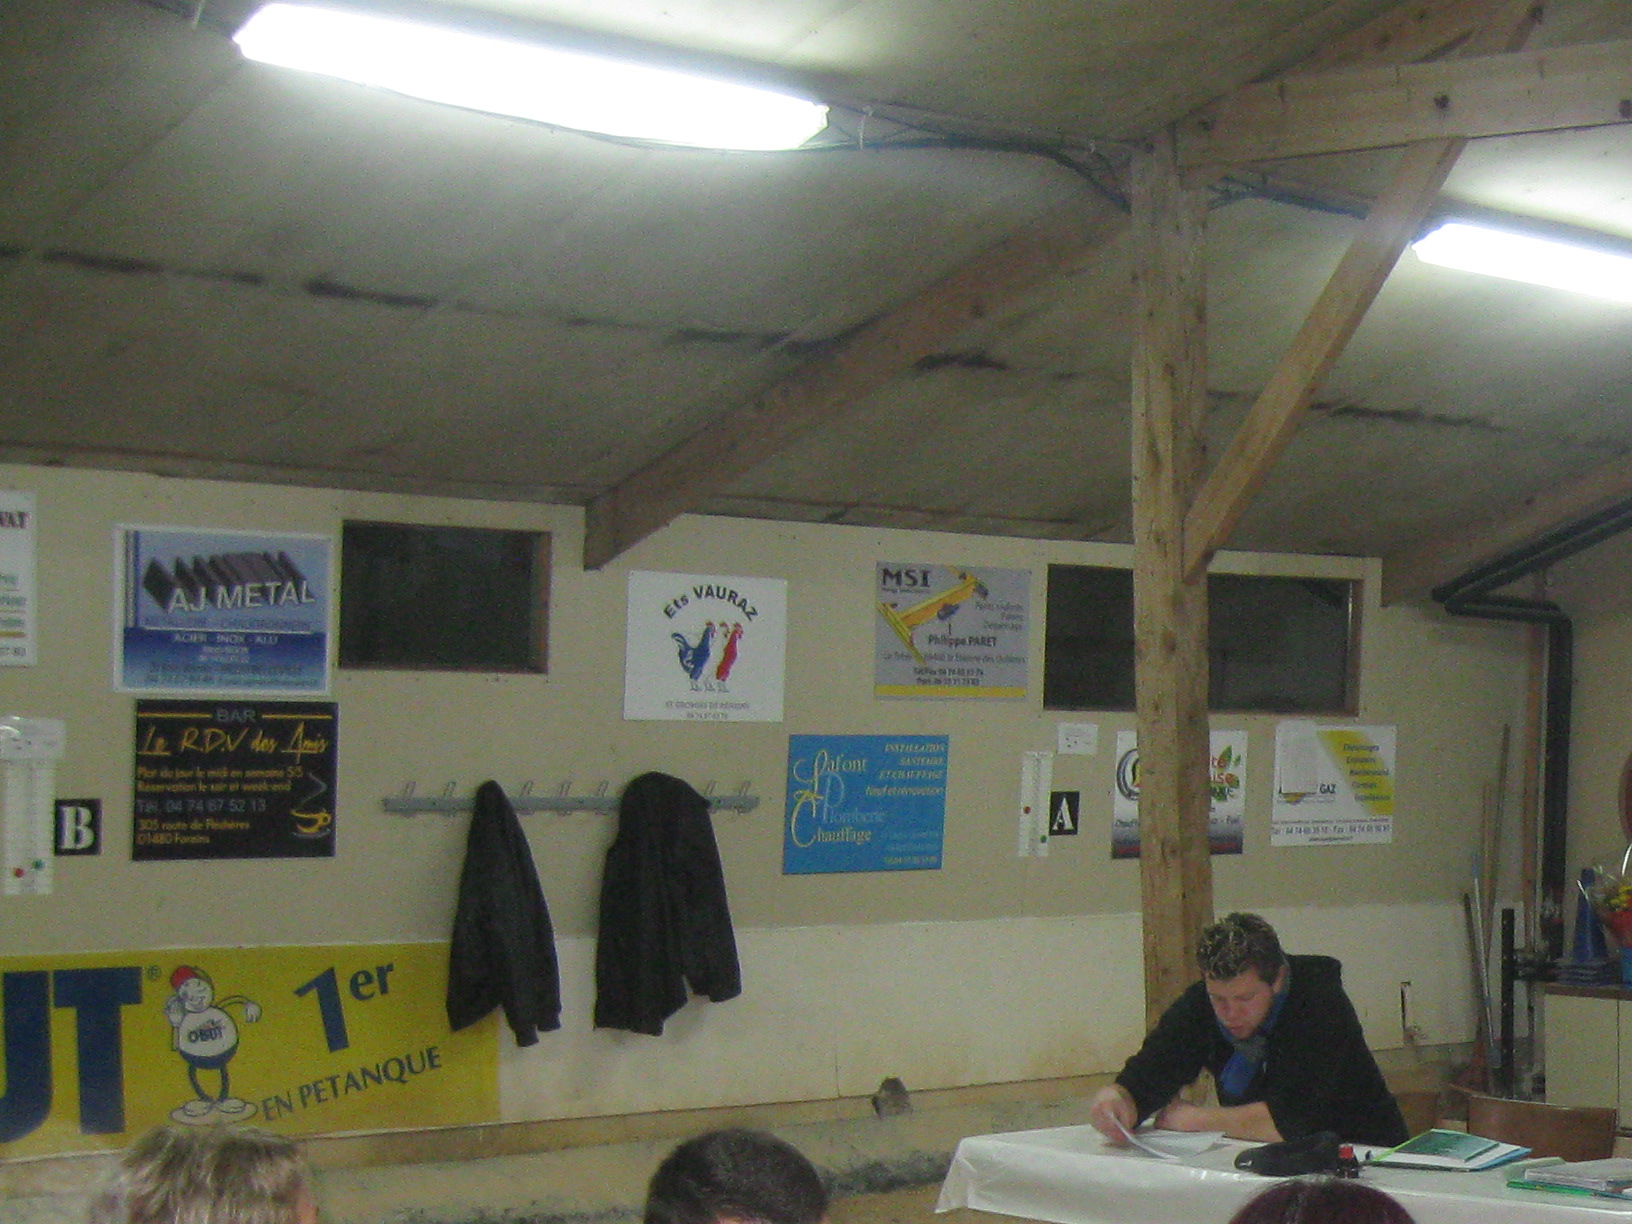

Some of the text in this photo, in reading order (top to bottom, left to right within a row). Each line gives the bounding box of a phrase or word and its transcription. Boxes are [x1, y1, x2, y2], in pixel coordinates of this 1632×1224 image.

[881, 567, 931, 588] MSI
[166, 579, 316, 614] AJ METAL
[662, 584, 759, 622] Ets VAURAZ
[968, 635, 998, 648] PARET
[216, 708, 257, 723] BAR
[138, 725, 172, 756] Le
[251, 729, 278, 753] des
[281, 721, 329, 765] Amis
[1319, 783, 1337, 795] GAZ
[60, 805, 96, 850] B
[1051, 796, 1075, 830] A
[260, 1045, 442, 1122] EN PETANQUE
